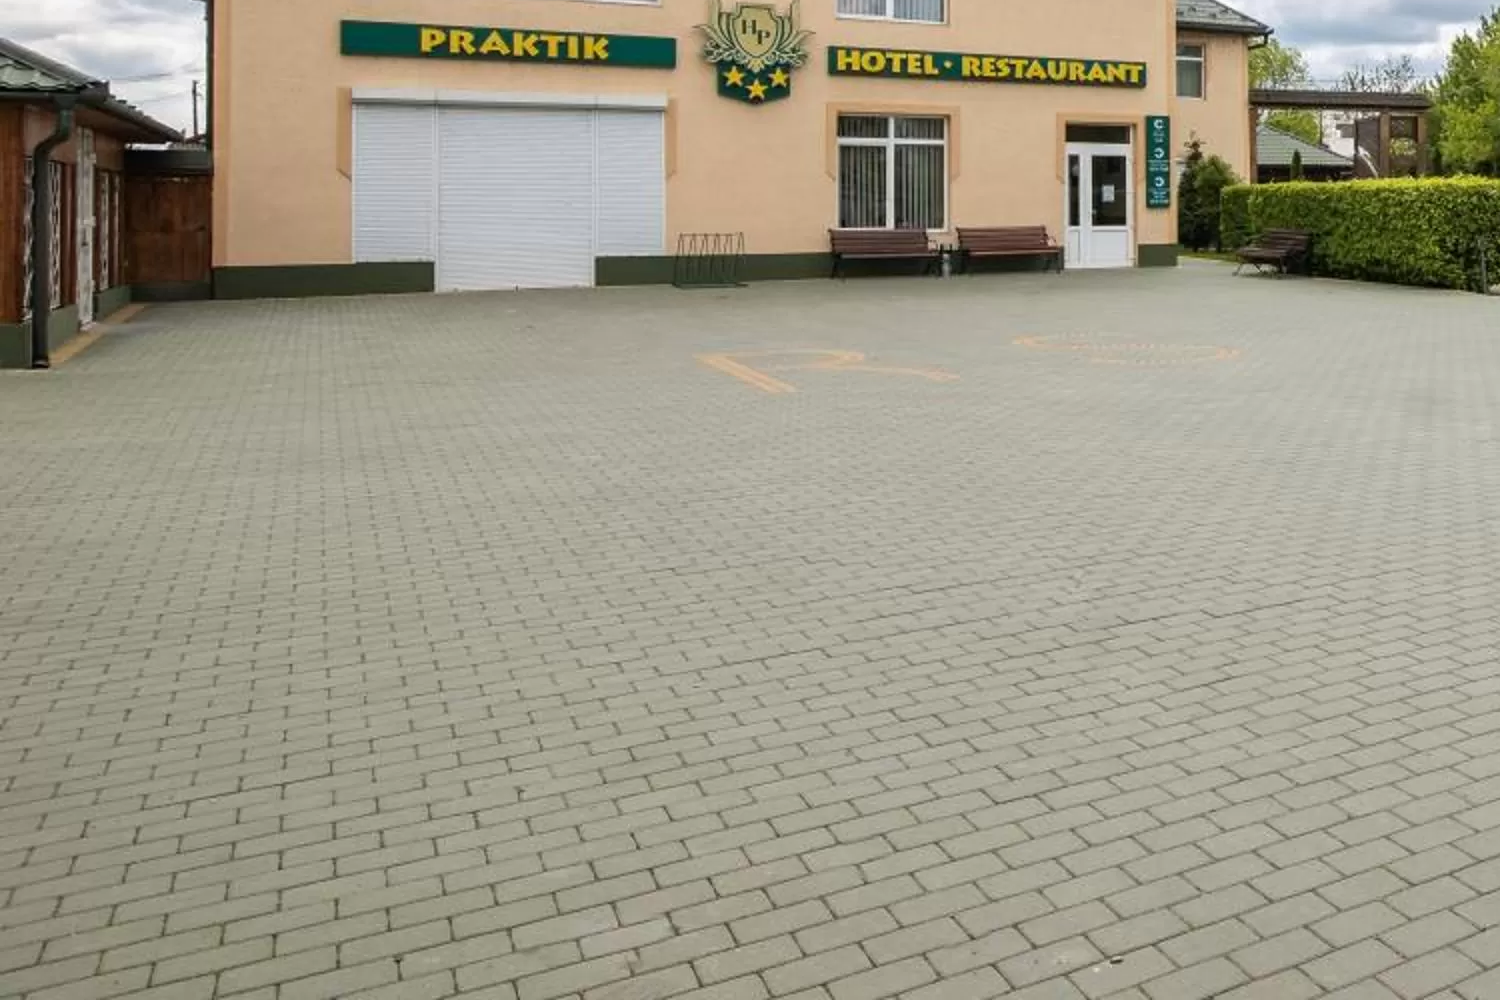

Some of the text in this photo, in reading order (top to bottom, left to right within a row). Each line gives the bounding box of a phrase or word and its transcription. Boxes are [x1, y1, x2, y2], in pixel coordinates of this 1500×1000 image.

[420, 27, 609, 60] PRAKTIK
[836, 50, 1143, 83] HOTEL RESTAURANT
